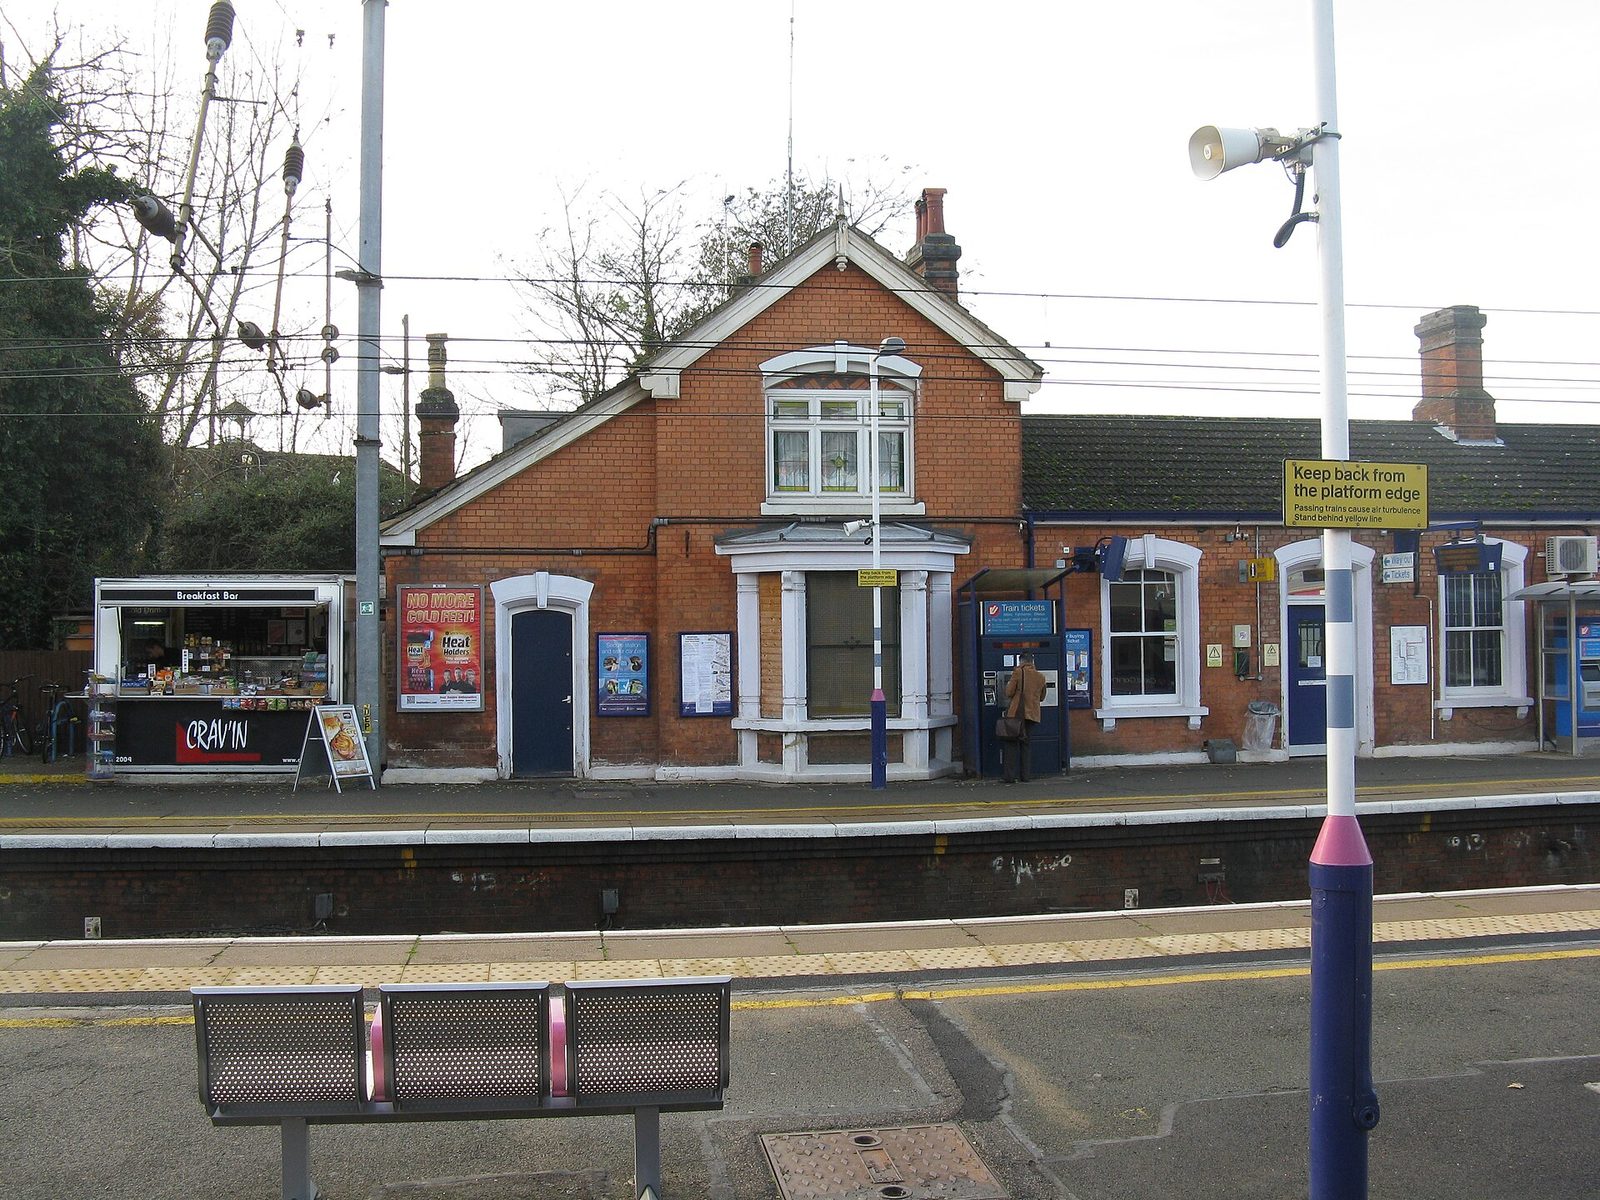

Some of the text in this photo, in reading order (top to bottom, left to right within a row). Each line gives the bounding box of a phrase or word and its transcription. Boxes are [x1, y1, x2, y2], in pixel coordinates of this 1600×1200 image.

[1293, 465, 1405, 483] Keep back from
[1293, 483, 1421, 502] the platform edge
[1294, 503, 1324, 513] Passing
[1325, 504, 1346, 513] trains
[1382, 506, 1421, 515] turbulence
[1294, 513, 1382, 523] Stand behind yellow line
[176, 591, 239, 600] Breakfast Bar
[406, 592, 475, 609] NO MORE
[1001, 604, 1045, 612] Train tickets
[406, 610, 475, 623] COLD FEET!
[442, 636, 470, 648] Heat
[443, 648, 470, 656] Holders
[186, 718, 248, 750] CRAV'IN
